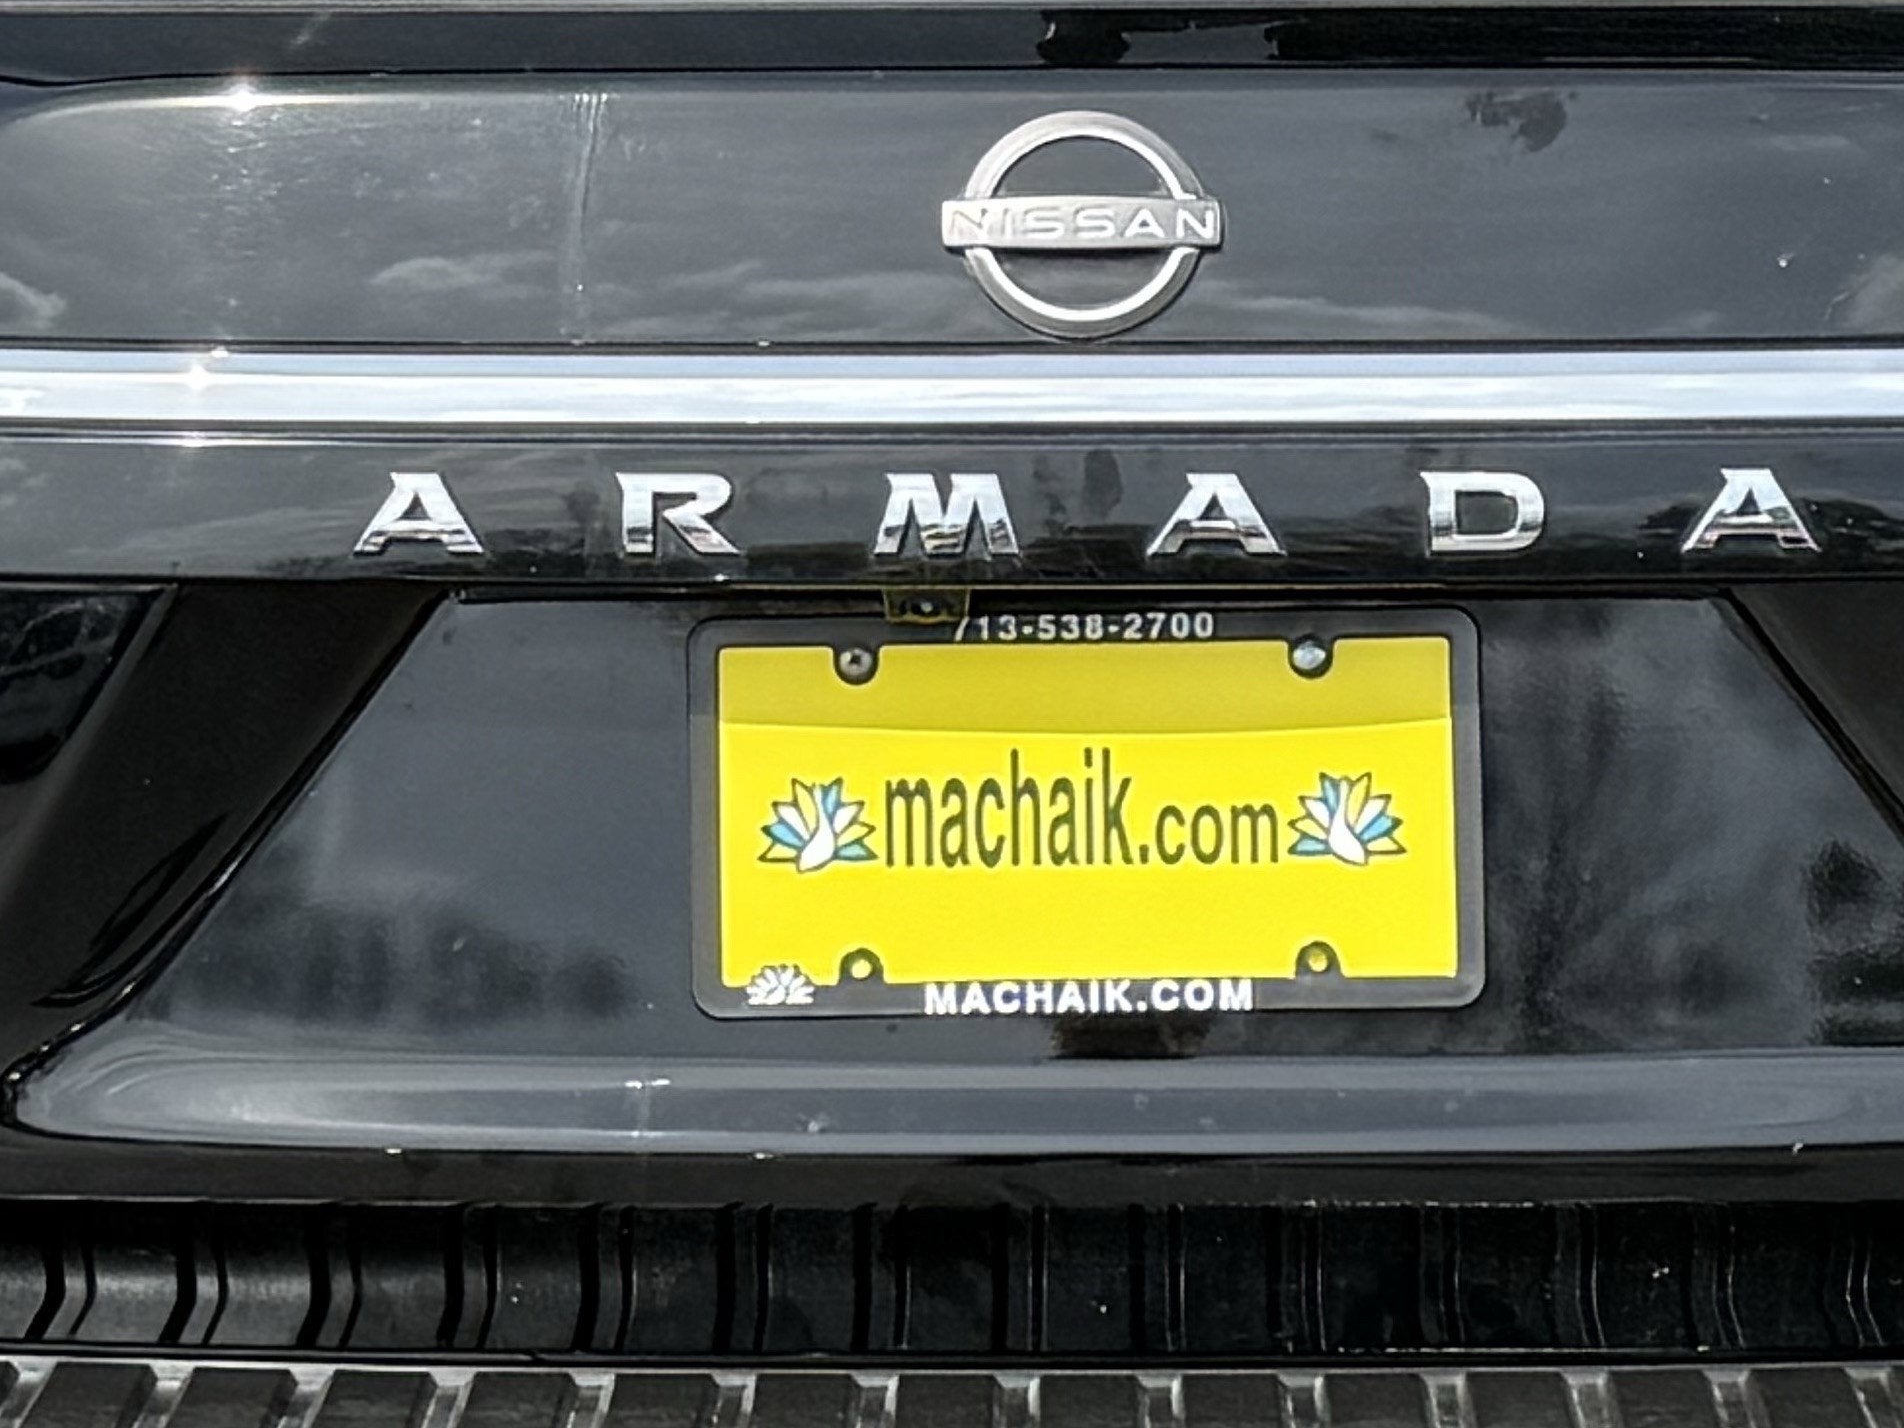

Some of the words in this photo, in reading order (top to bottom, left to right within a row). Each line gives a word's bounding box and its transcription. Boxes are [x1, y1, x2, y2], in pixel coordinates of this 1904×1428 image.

[946, 202, 1219, 242] NISSAN
[353, 467, 1821, 556] ARMADA
[884, 747, 1281, 868] machaik.com
[923, 978, 1254, 1015] MACHAIK.COM
